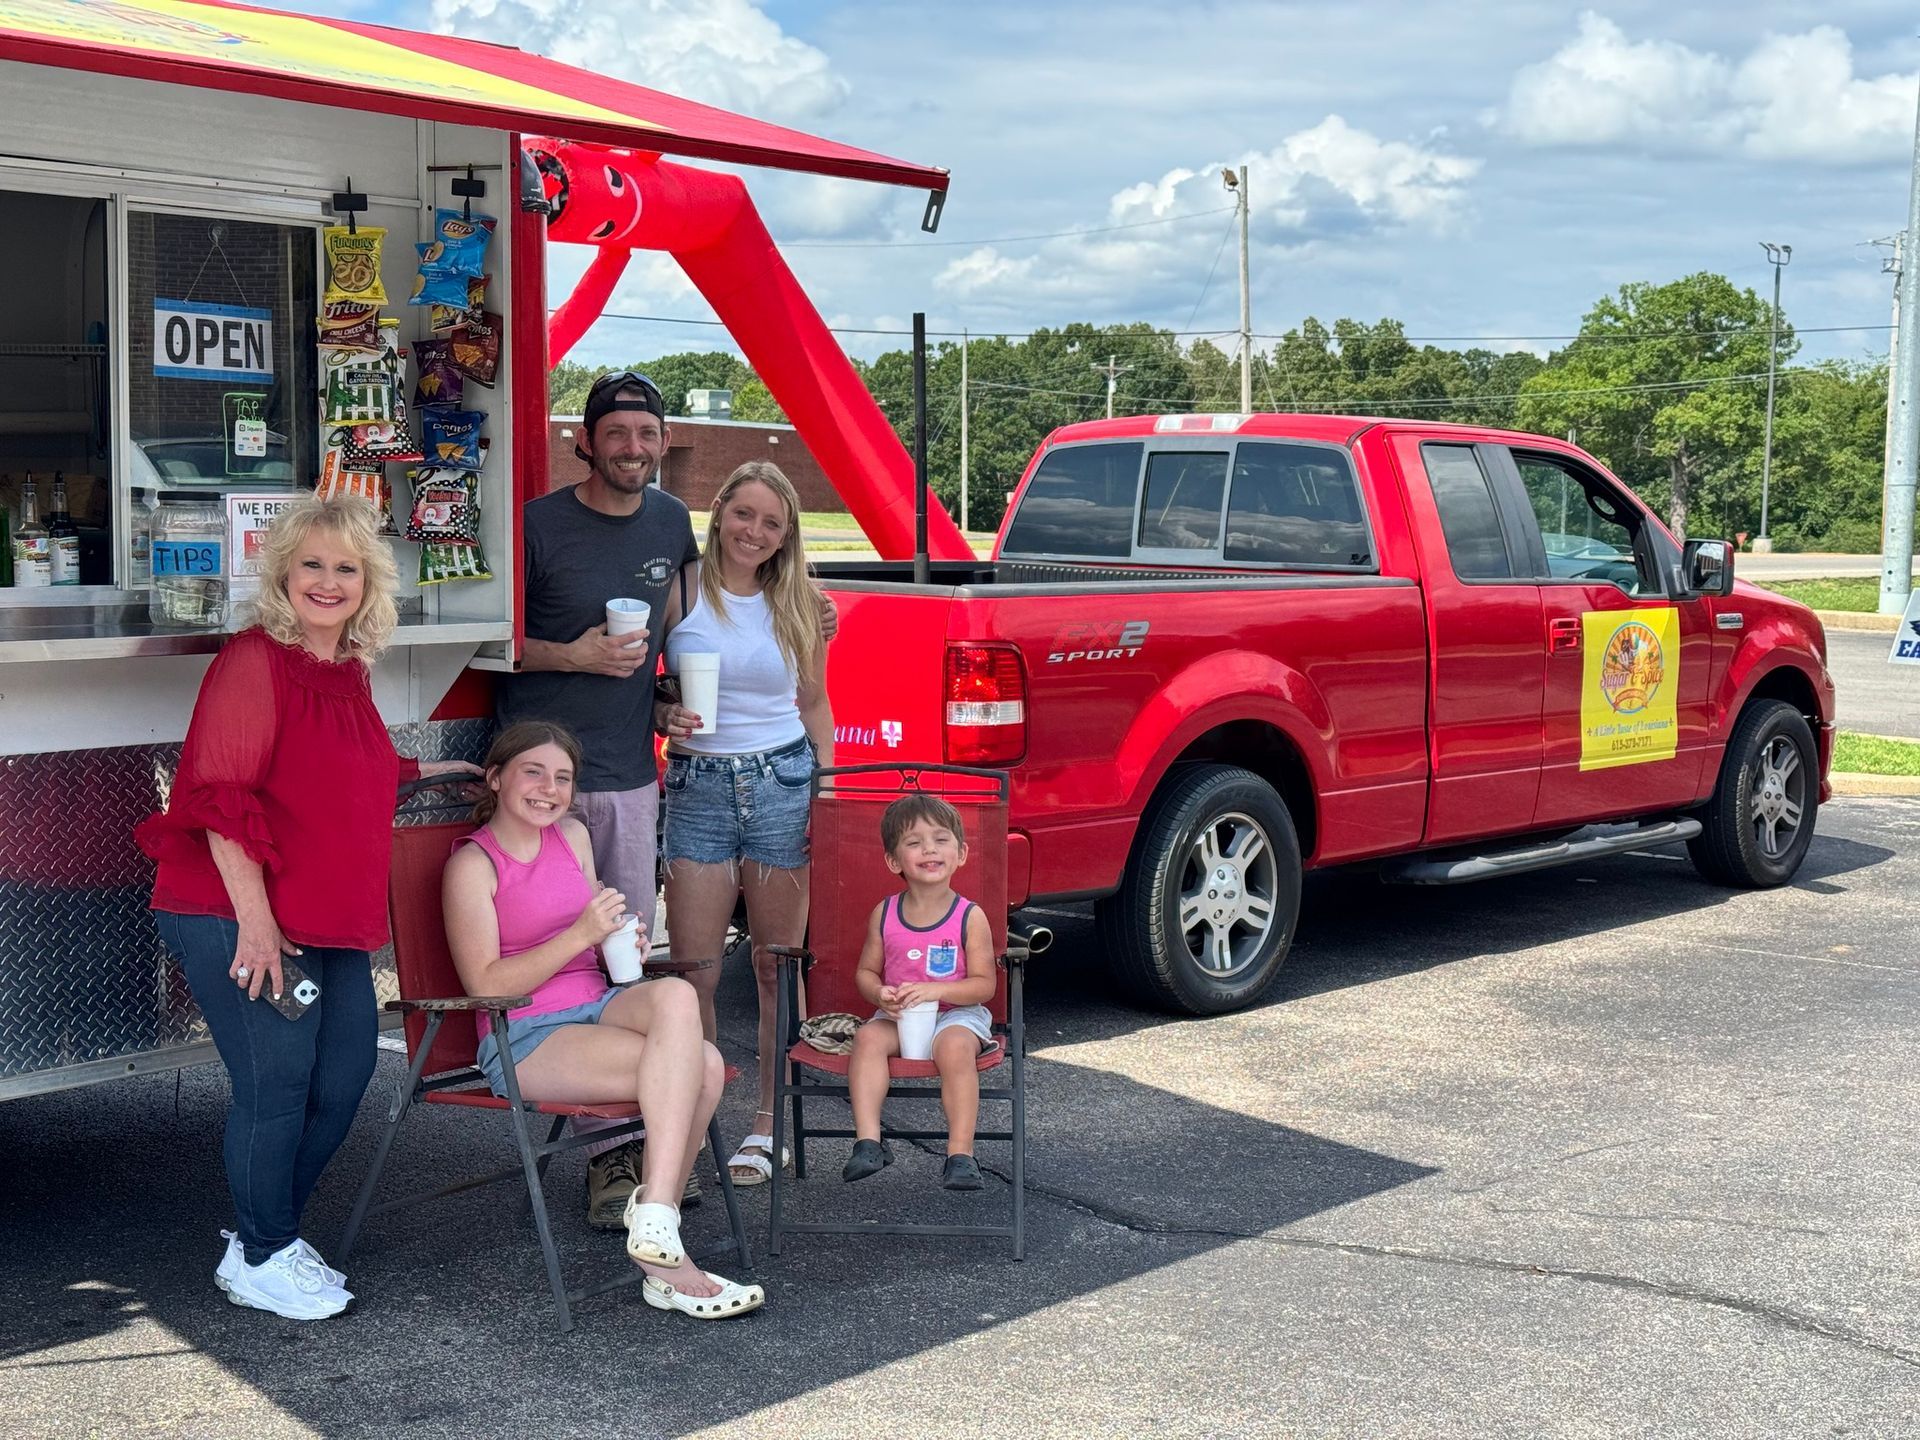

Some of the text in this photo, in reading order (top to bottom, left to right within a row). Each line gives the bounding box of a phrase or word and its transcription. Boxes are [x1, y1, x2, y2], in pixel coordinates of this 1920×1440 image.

[165, 316, 265, 370] OPEN
[233, 398, 259, 416] TAP
[433, 422, 473, 434] Doritos
[238, 502, 290, 515] WE RES
[155, 547, 214, 572] TIPS
[1053, 620, 1150, 648] FX2
[1046, 648, 1142, 664] SPORT
[1601, 668, 1629, 690] Sugar
[1640, 667, 1664, 690] Spice
